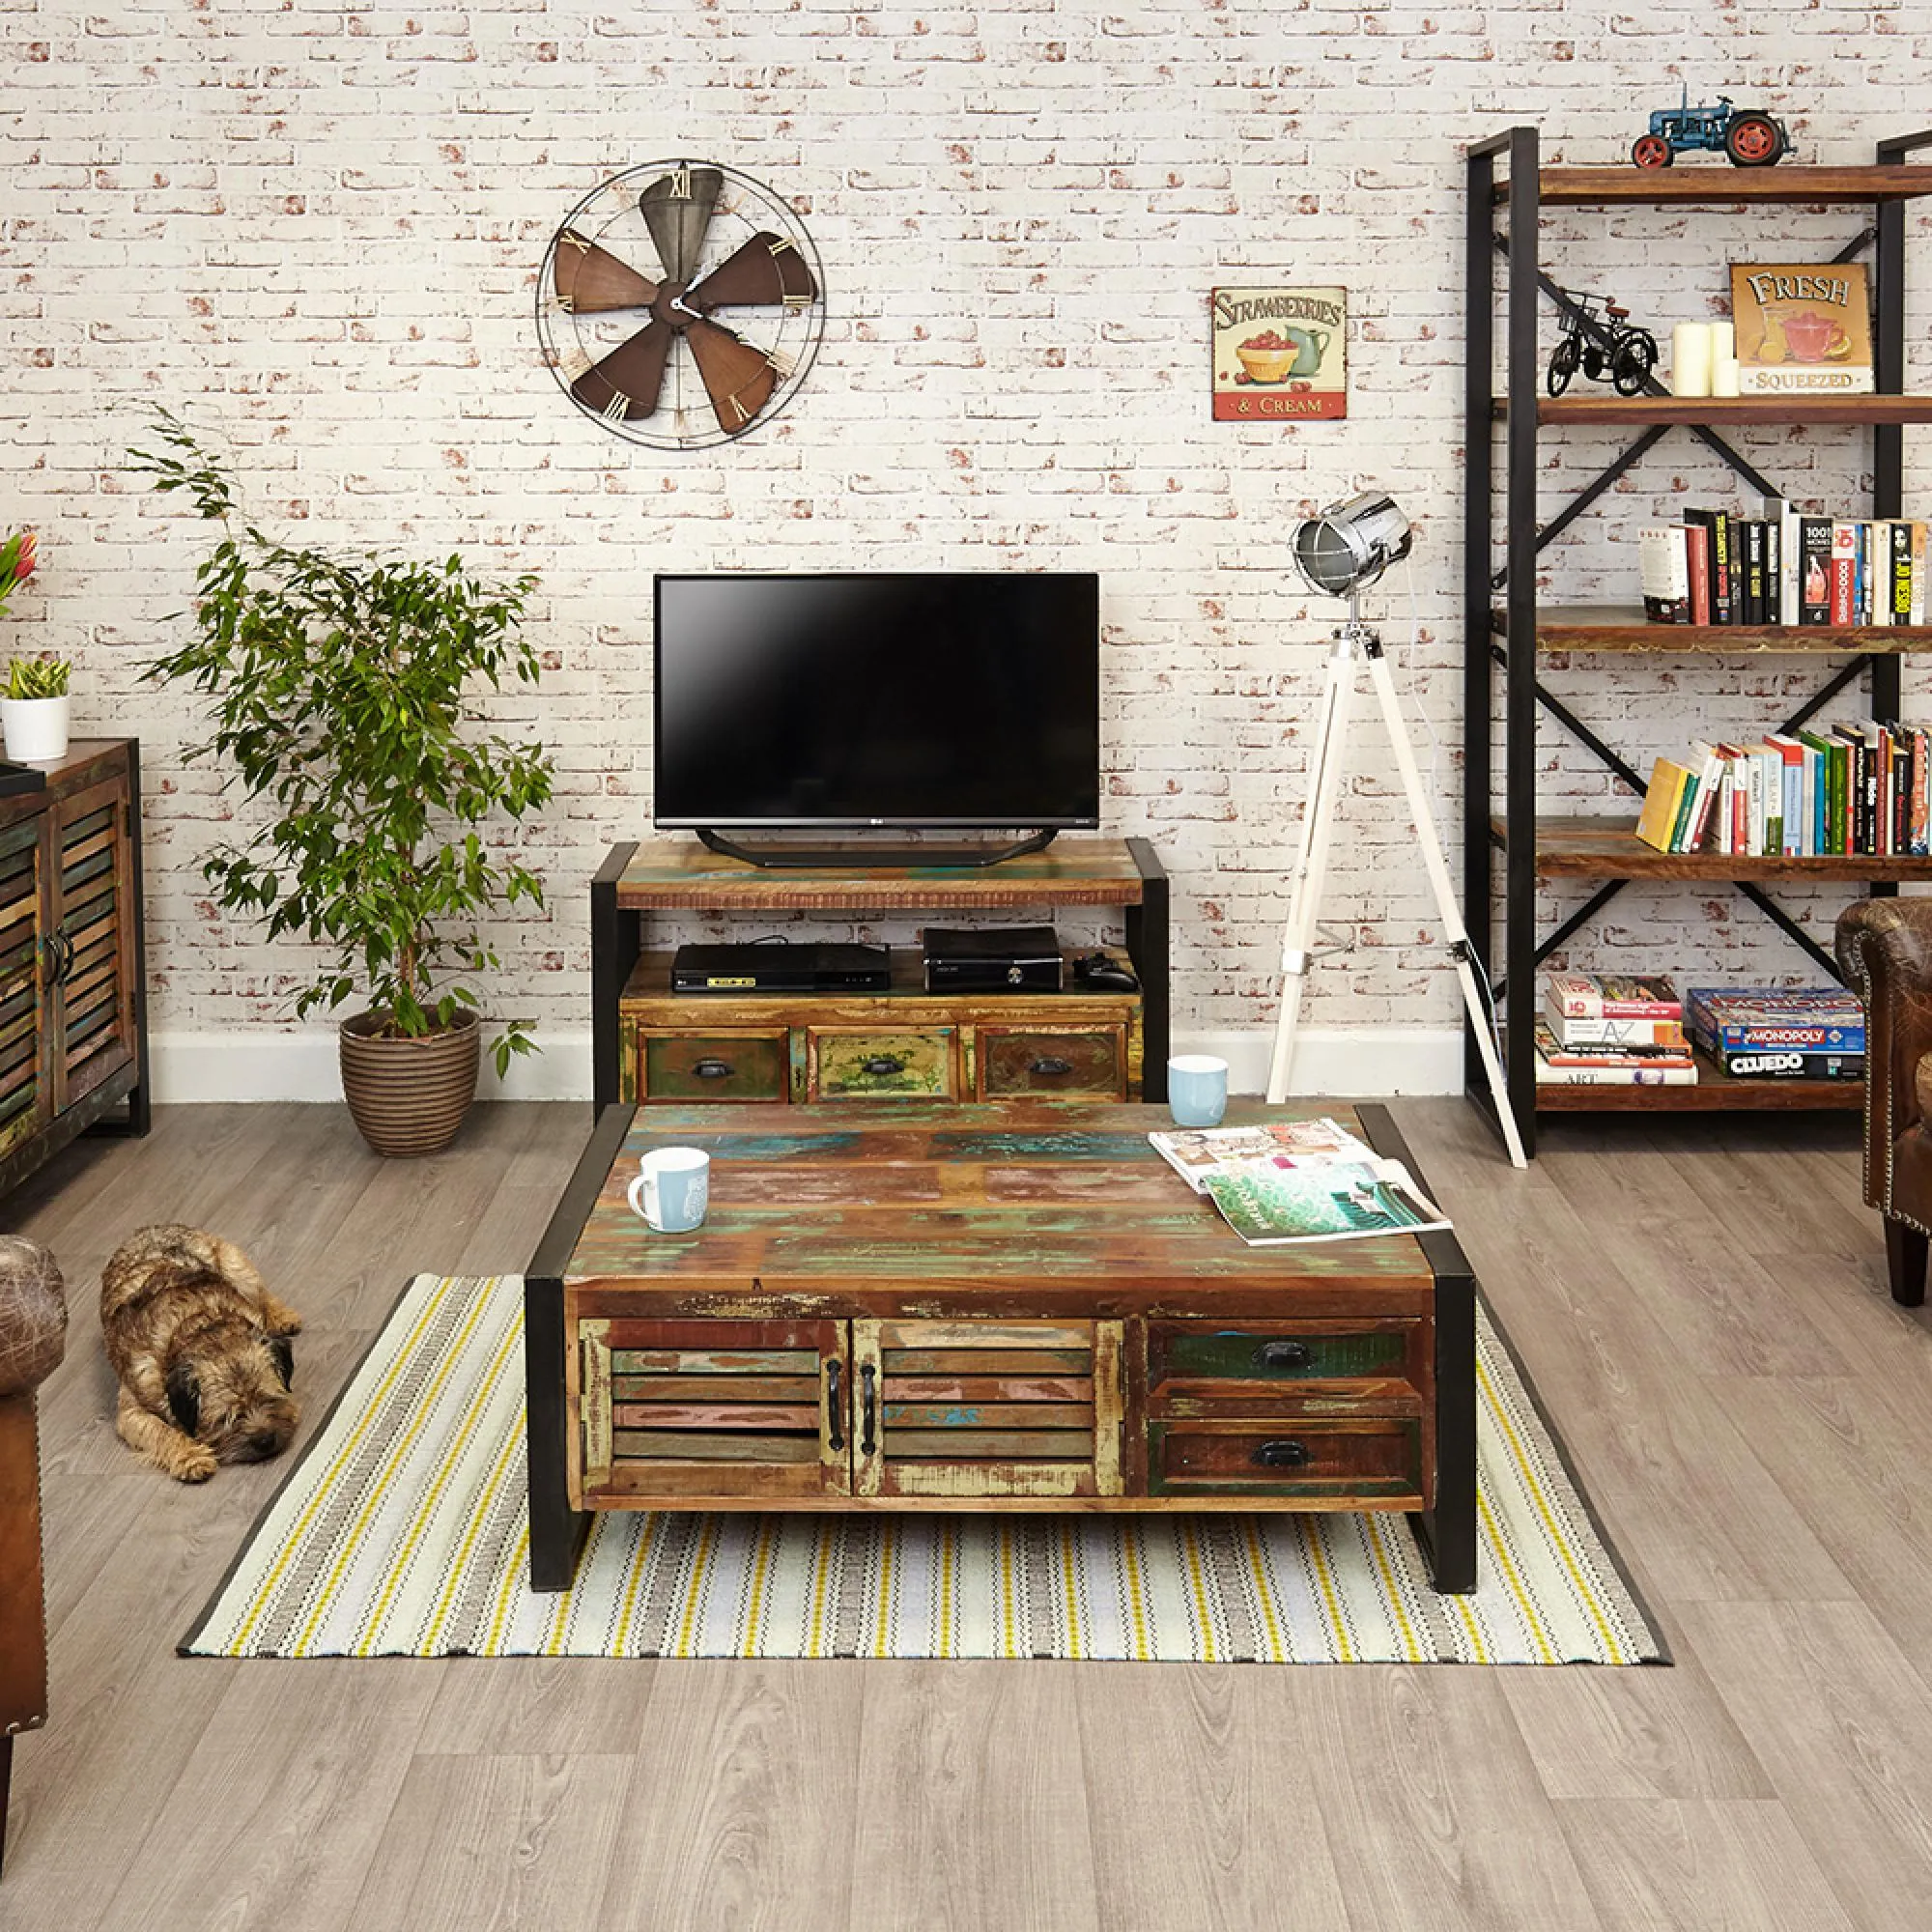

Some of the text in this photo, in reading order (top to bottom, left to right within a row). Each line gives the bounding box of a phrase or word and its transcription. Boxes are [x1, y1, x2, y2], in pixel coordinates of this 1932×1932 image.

[1747, 271, 1850, 307] FRESH
[1215, 293, 1342, 330] STRAWBERRIES
[1755, 371, 1853, 390] SQUEEZED
[1236, 397, 1322, 414] & CREAM
[1750, 1029, 1825, 1044] MONOPOLY
[1730, 1054, 1804, 1074] CLUEDO
